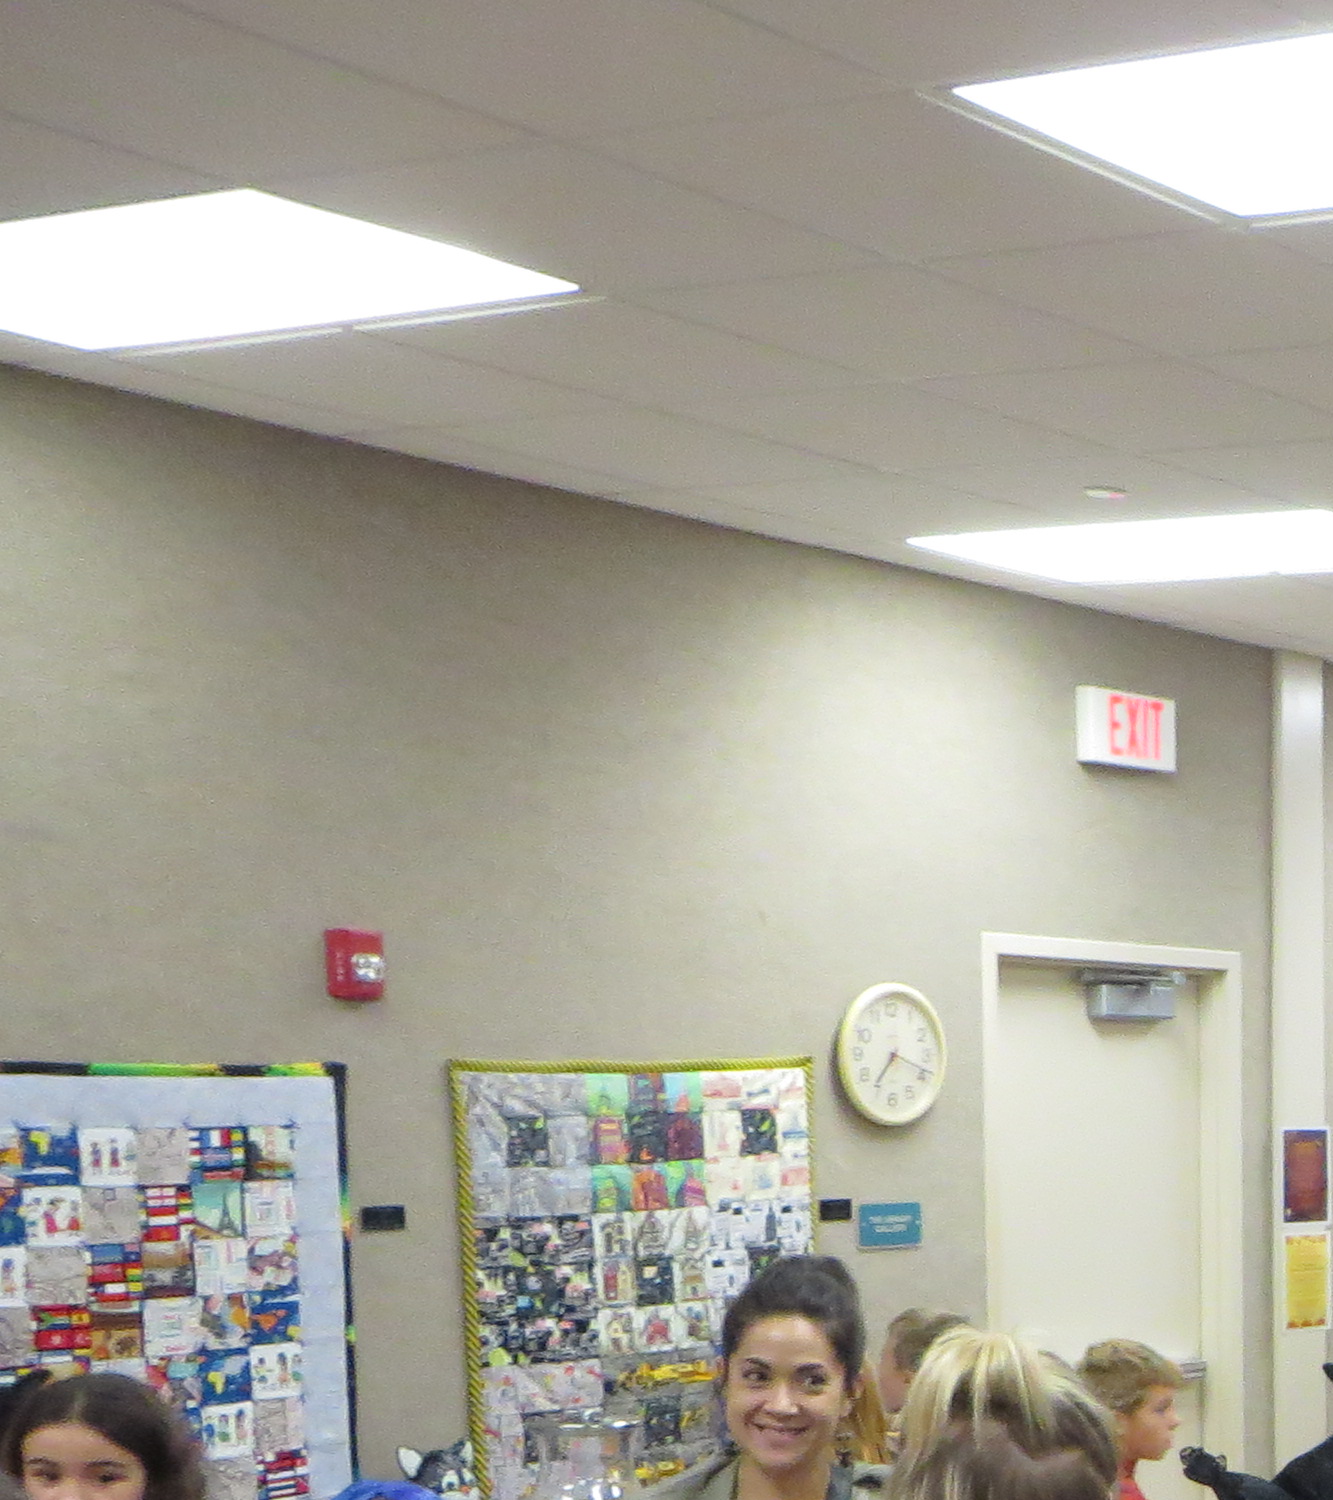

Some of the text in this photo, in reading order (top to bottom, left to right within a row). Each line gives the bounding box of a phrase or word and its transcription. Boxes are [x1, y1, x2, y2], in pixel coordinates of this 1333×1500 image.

[1109, 694, 1165, 760] EXIT
[885, 1001, 897, 1017] 12
[857, 1027, 872, 1044] 10
[916, 1027, 927, 1043] 2
[853, 1047, 864, 1062] 9
[860, 1066, 870, 1082] 8
[887, 1092, 898, 1107] 6
[904, 1085, 915, 1100] 5
